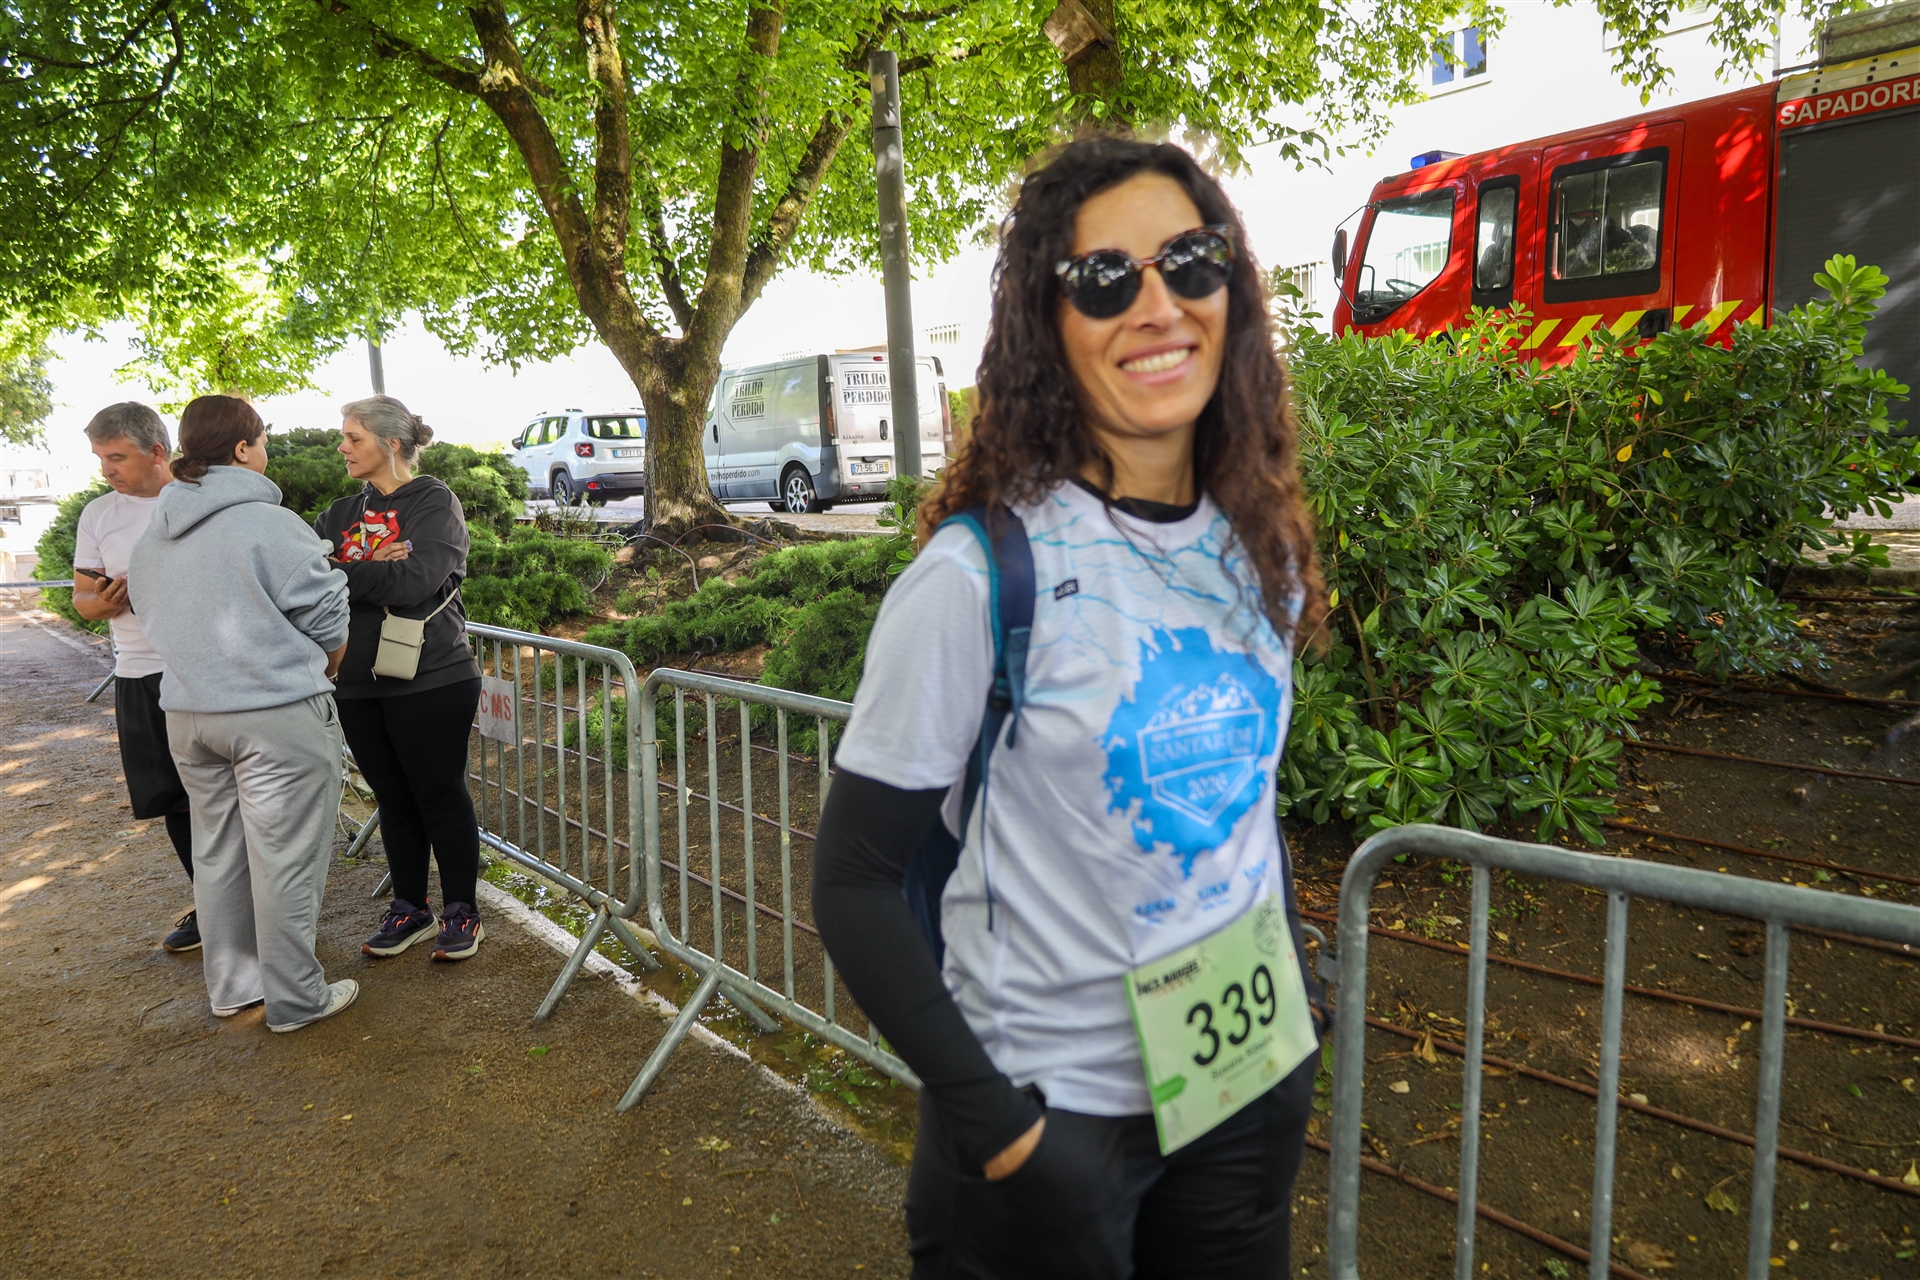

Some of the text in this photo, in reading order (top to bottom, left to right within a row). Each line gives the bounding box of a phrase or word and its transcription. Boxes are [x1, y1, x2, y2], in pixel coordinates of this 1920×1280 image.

[844, 373, 887, 386] TRILHO
[735, 381, 763, 397] TRILHO
[843, 391, 892, 403] PERDIDO
[732, 401, 765, 418] PERDIDO
[1187, 965, 1276, 1067] 339
